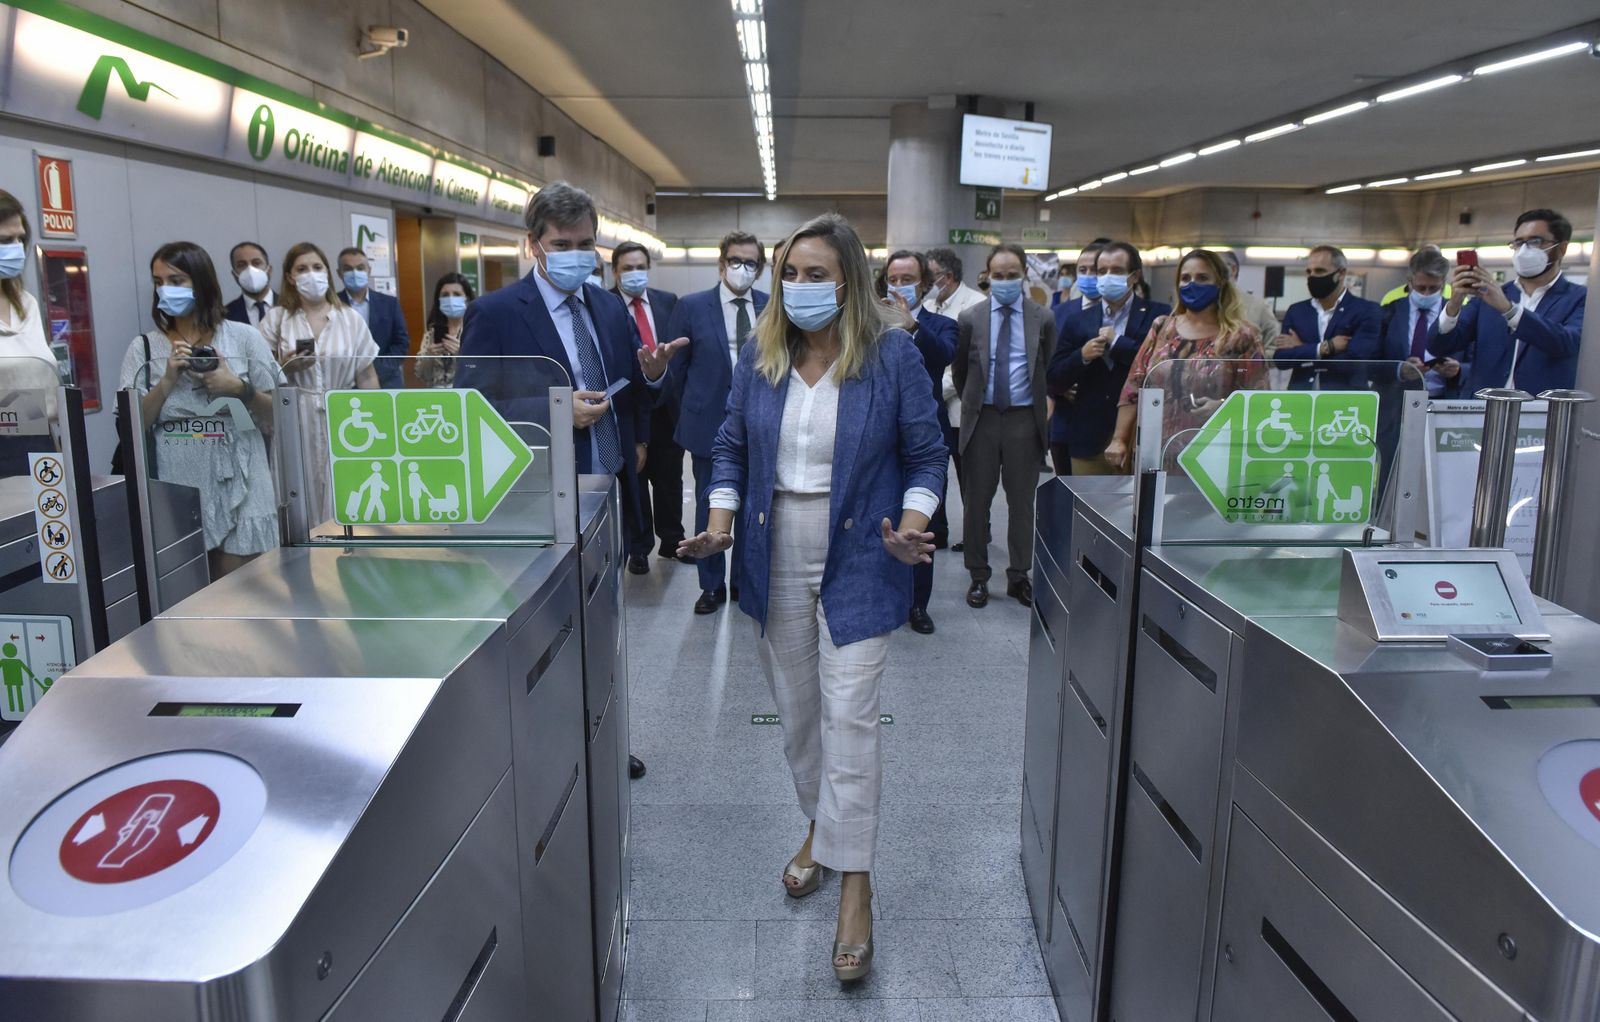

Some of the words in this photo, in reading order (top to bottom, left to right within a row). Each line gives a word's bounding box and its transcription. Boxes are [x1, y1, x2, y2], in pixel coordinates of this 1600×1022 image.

[975, 129, 991, 137] Metro
[1001, 132, 1019, 140] Sevilla
[284, 128, 349, 174] Oficina
[353, 151, 372, 179] de
[434, 178, 443, 198] al
[43, 213, 74, 230] POLVO
